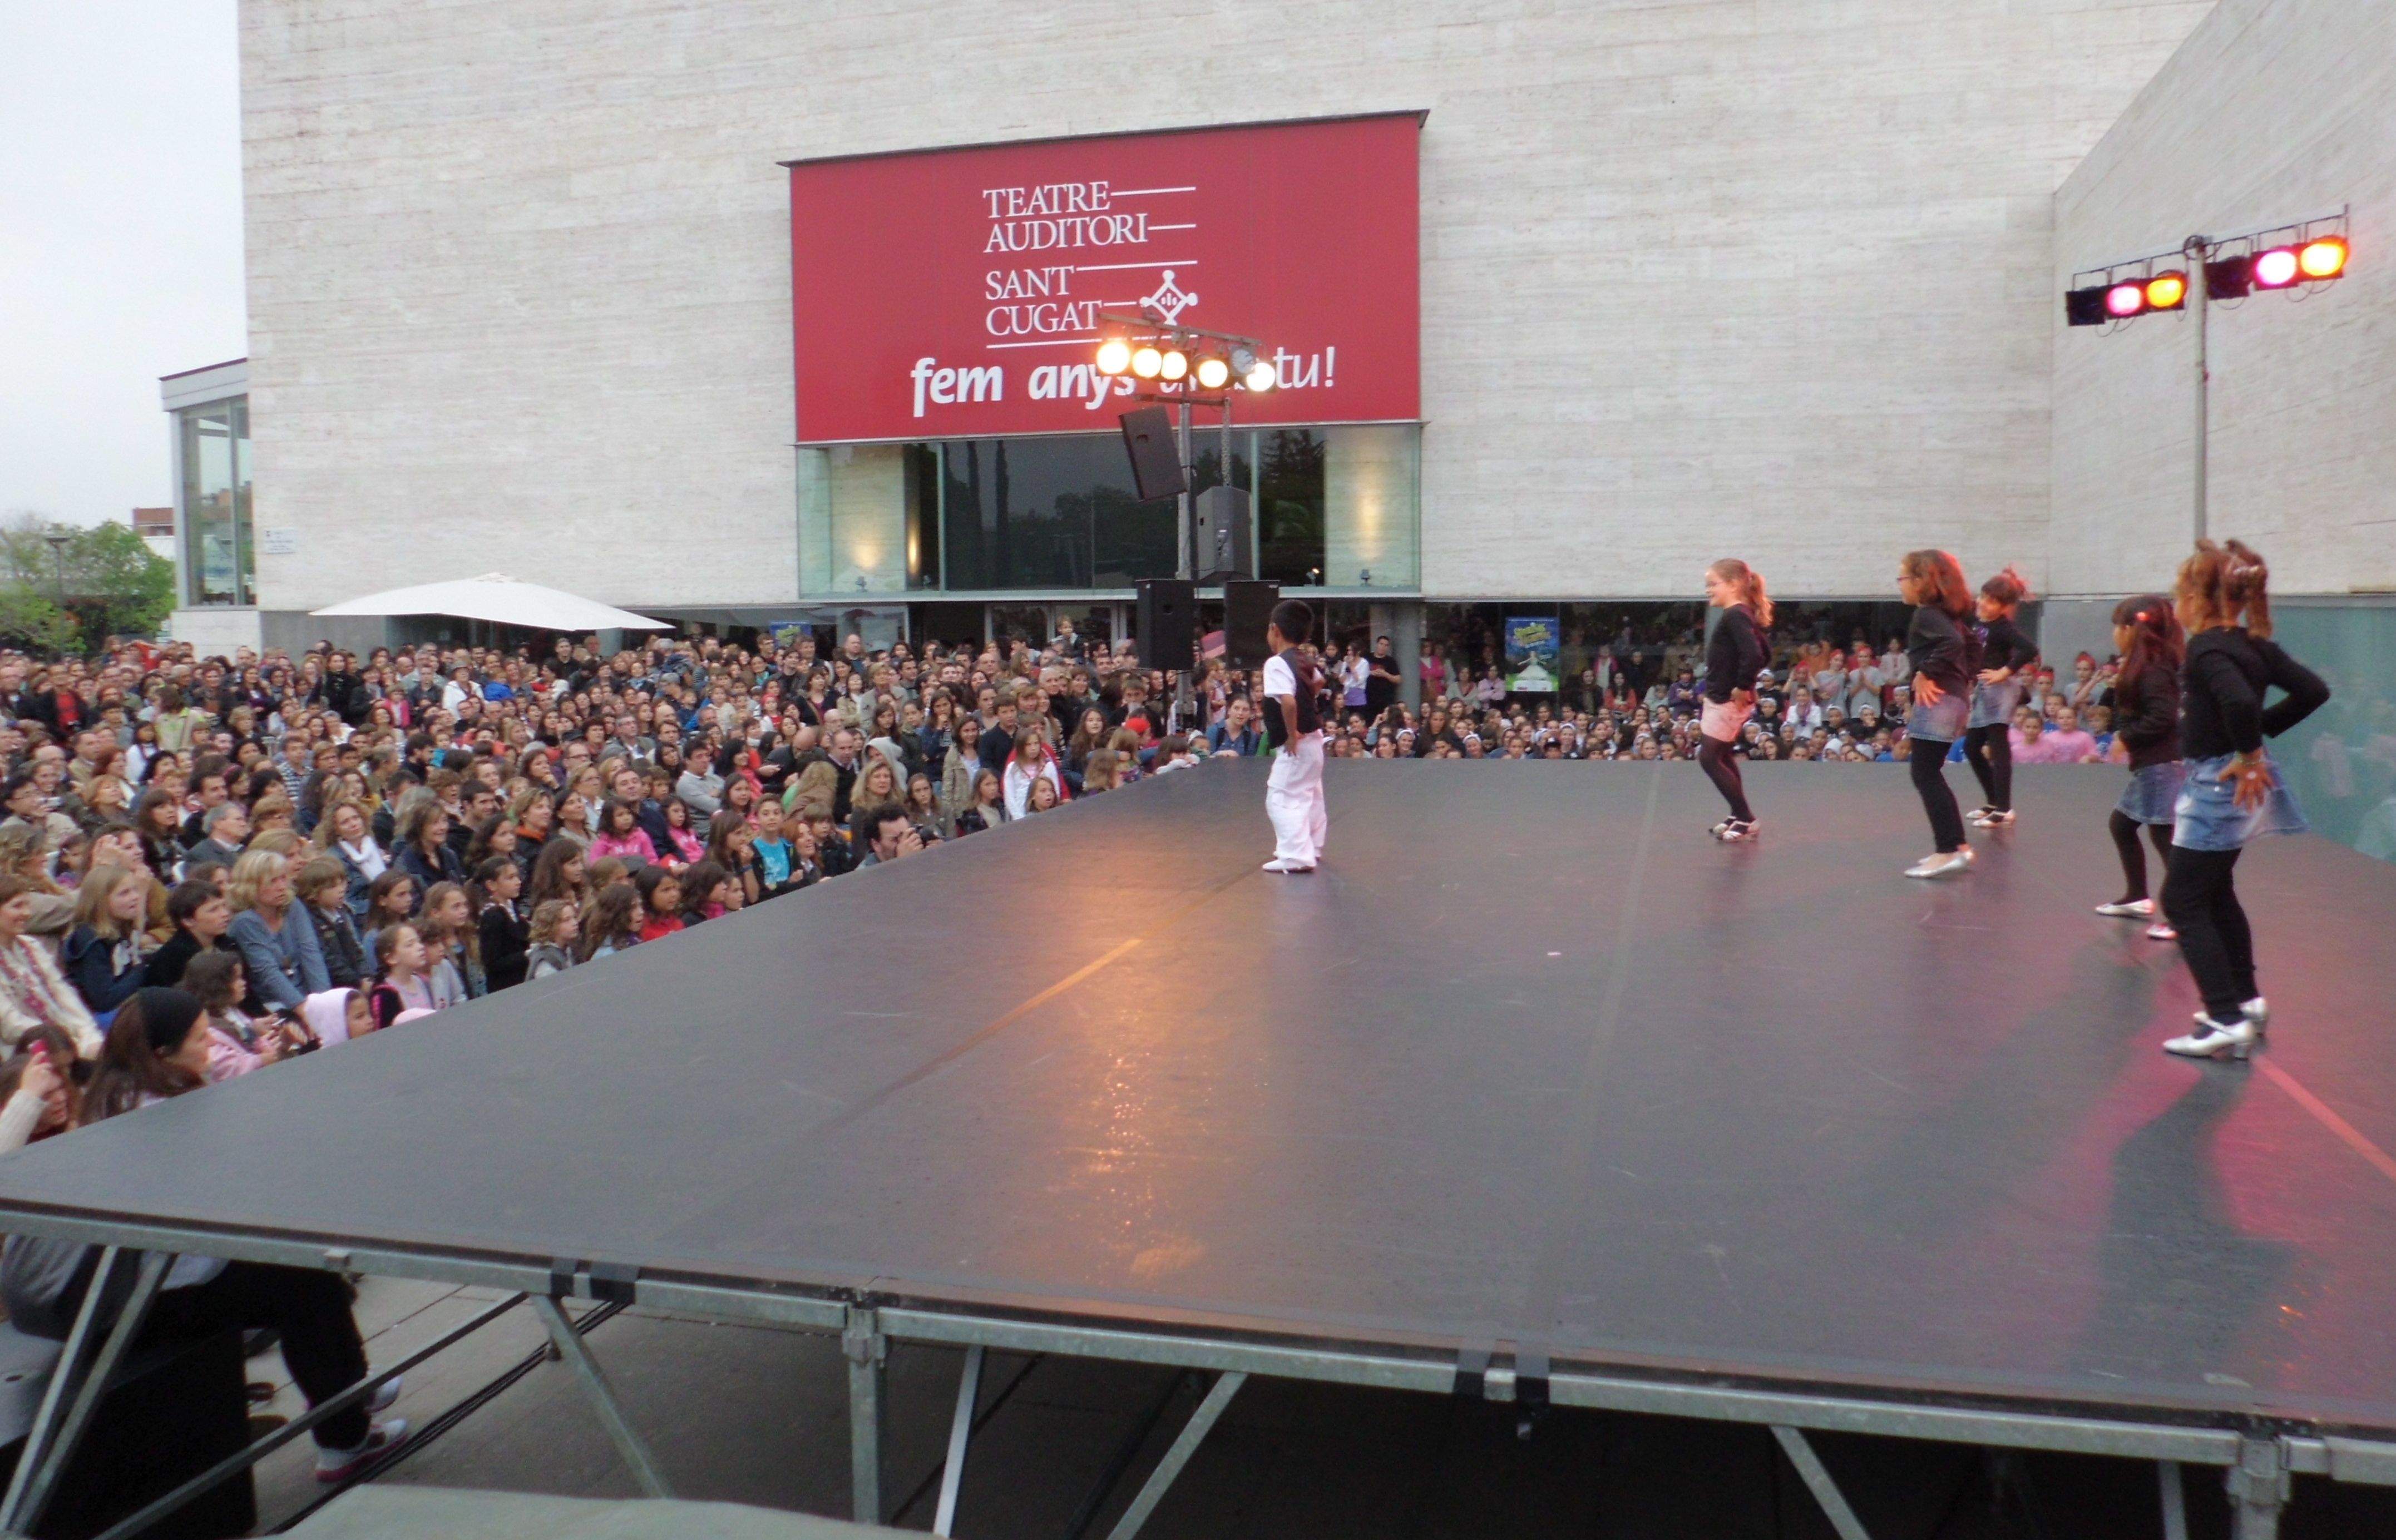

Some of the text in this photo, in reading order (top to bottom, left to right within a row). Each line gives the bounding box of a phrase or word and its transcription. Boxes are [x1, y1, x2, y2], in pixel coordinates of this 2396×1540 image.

[983, 181, 1110, 219] TEATRE
[983, 213, 1148, 254] AUDITORI
[986, 265, 1075, 300] SANT
[986, 300, 1103, 336] CUGAT
[911, 357, 1003, 418] fem
[1273, 346, 1335, 389] tu!
